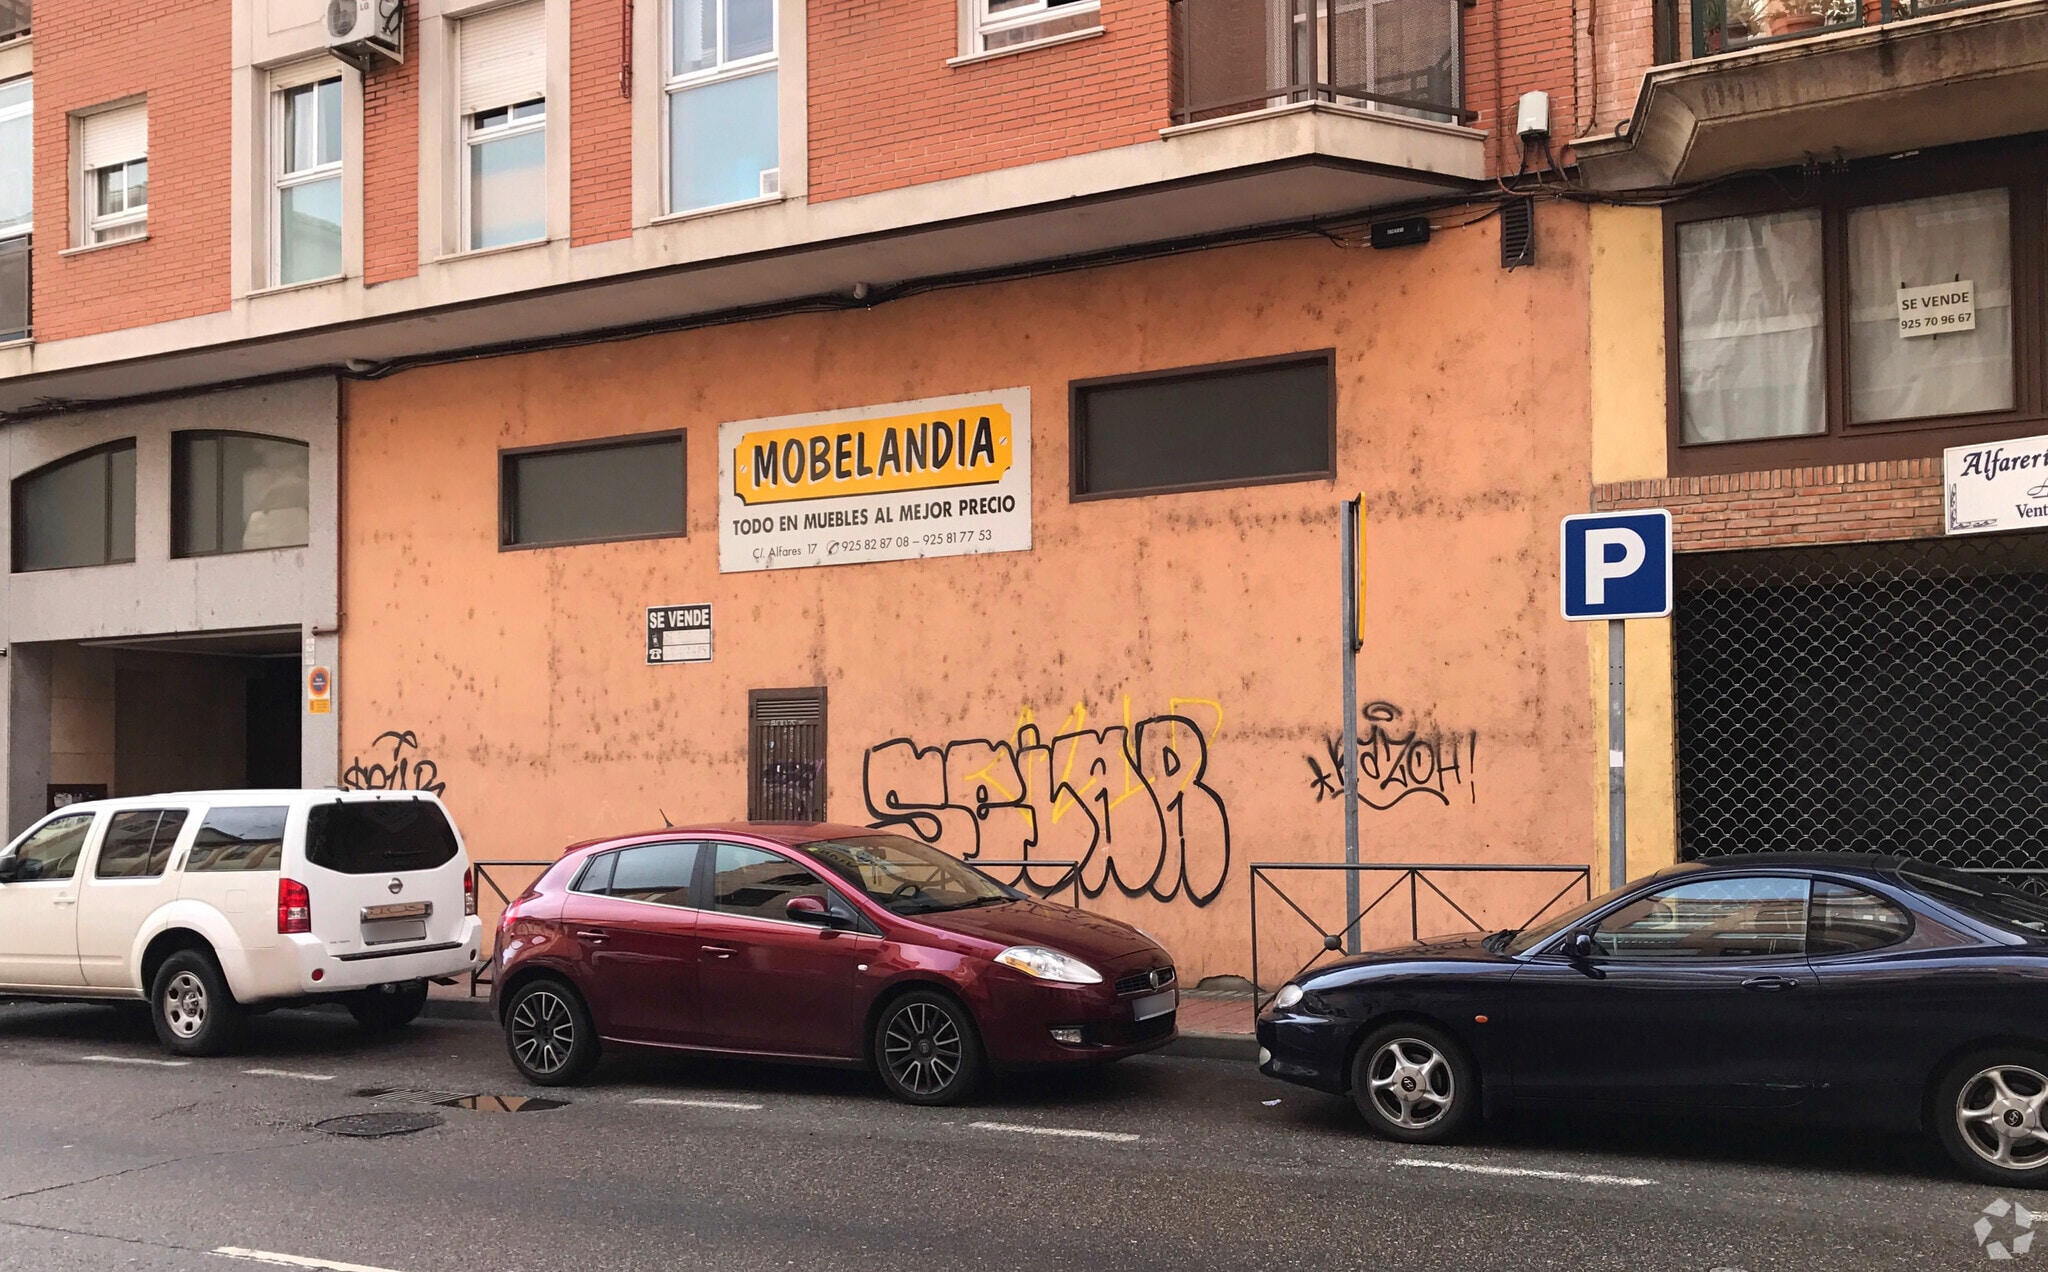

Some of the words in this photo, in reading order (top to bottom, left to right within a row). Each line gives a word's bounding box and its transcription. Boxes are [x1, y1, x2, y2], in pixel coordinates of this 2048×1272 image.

[1902, 299, 1917, 310] SE
[1921, 292, 1969, 308] VENDE
[1901, 319, 1921, 329] 925
[1924, 317, 1938, 326] 70
[1941, 314, 1955, 325] 96
[1958, 312, 1972, 322] 67
[753, 416, 995, 489] MOBELANDIA
[732, 517, 774, 535] TODO
[779, 514, 798, 531] EN
[803, 508, 868, 530] MUEBLES
[874, 507, 893, 524] AL
[899, 501, 952, 521] MEJOR
[959, 495, 1015, 516] PRECIO
[768, 545, 801, 558] Alfares
[807, 544, 817, 554] 17
[841, 540, 861, 551] 925
[864, 539, 876, 550] 82
[880, 537, 892, 549] 87
[896, 536, 909, 547] 08
[923, 533, 943, 545] 925
[978, 529, 992, 541] 53
[1585, 527, 1646, 605] P
[649, 611, 665, 629] SE
[668, 608, 709, 627] VENDE
